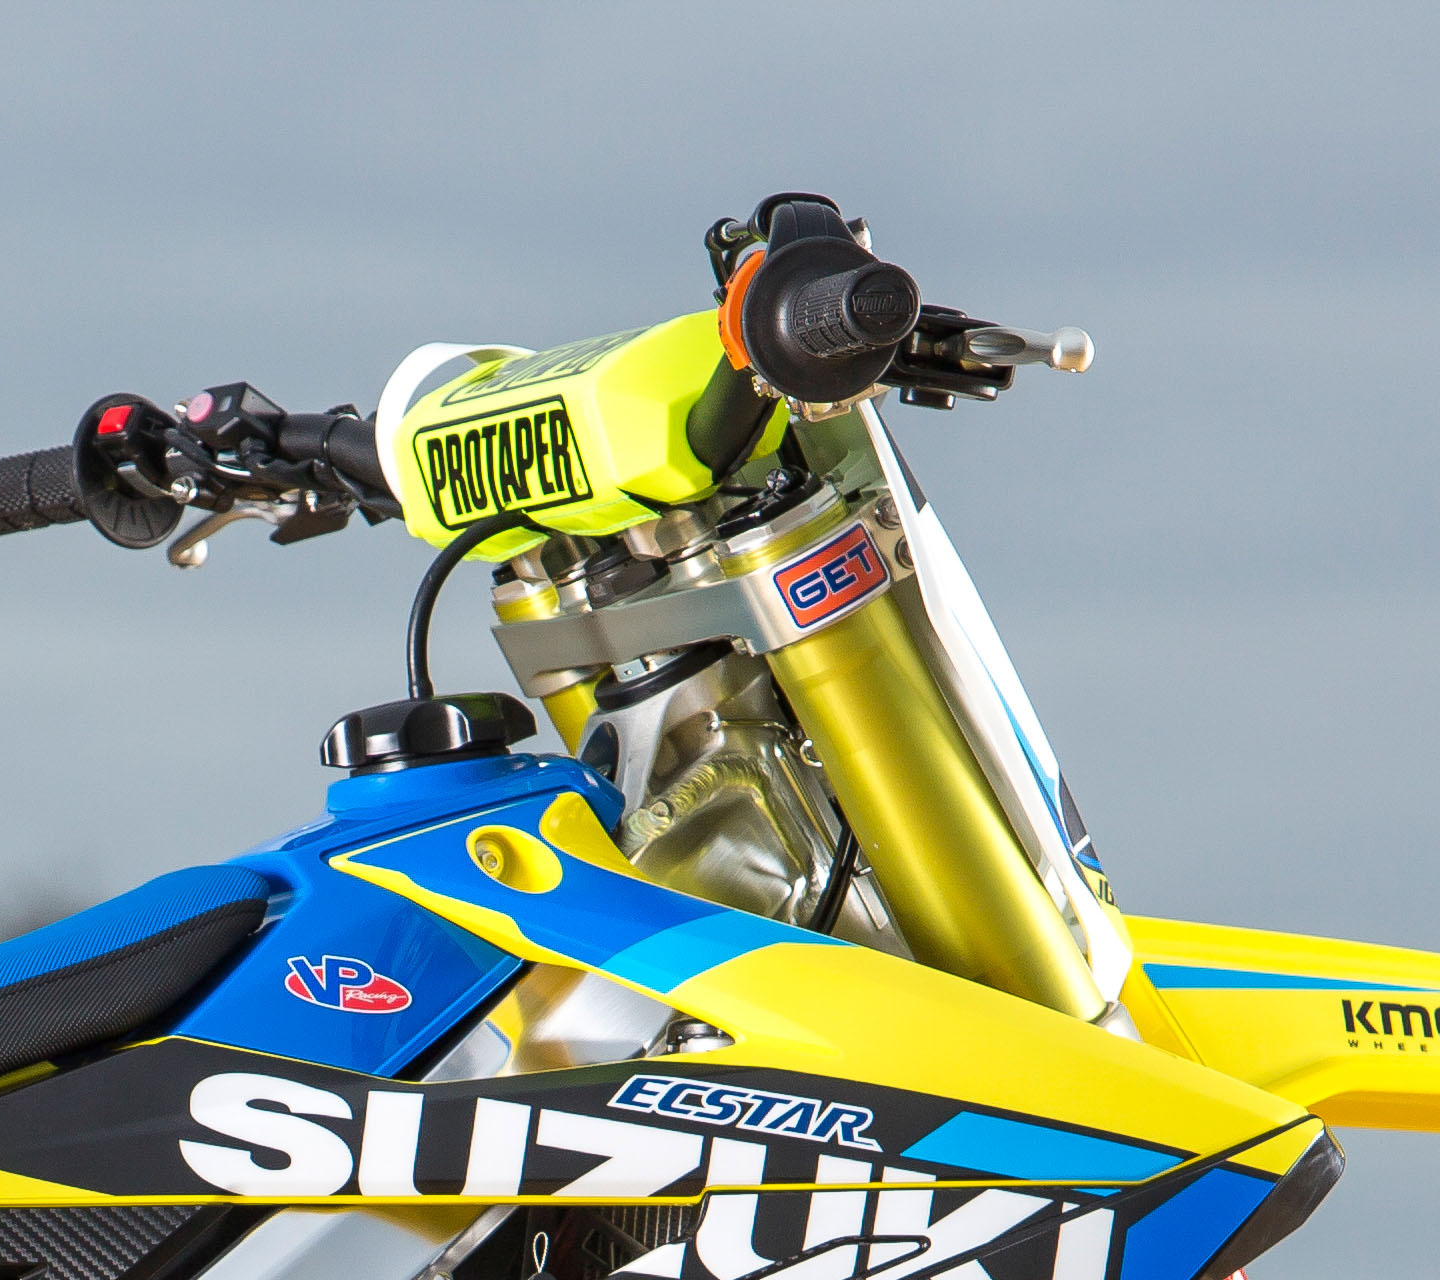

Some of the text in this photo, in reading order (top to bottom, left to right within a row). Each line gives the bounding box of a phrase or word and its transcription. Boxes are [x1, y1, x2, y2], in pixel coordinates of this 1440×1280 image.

[426, 409, 577, 516] PROTAPER
[788, 540, 872, 610] GET
[287, 955, 375, 1008] VP
[610, 1076, 882, 1152] ECSTAR
